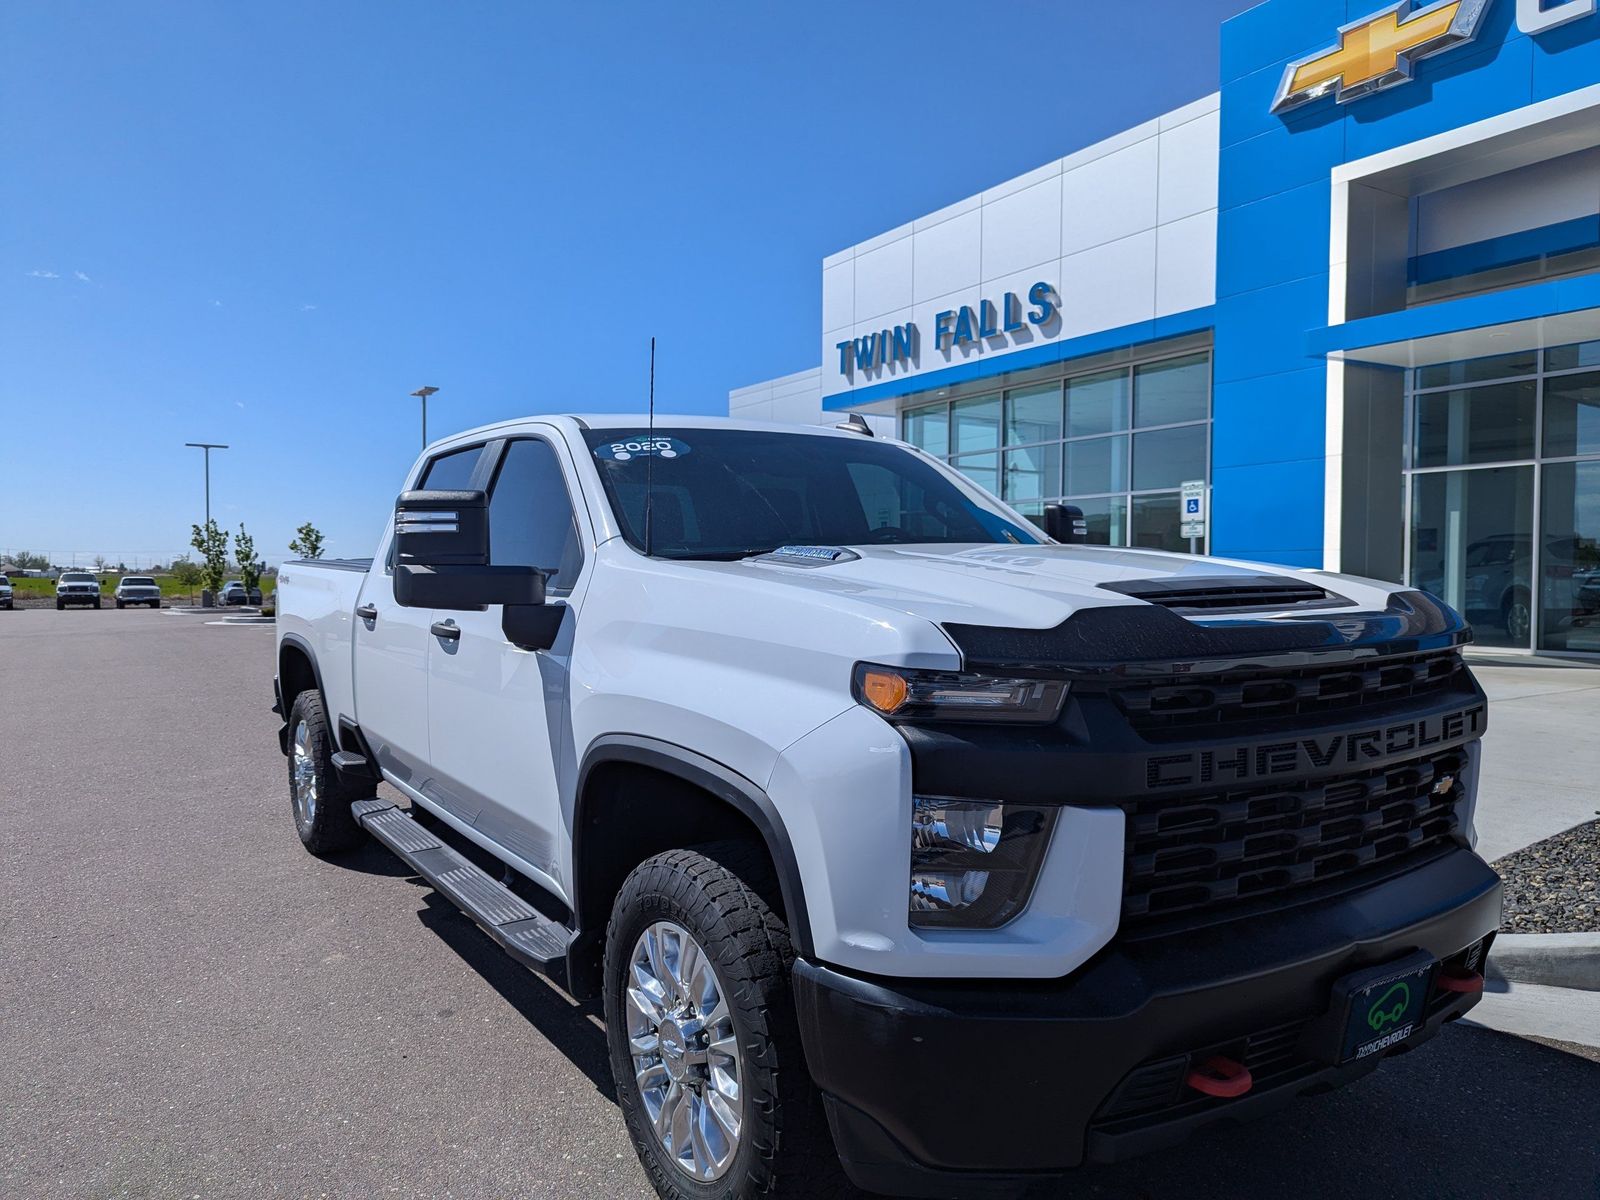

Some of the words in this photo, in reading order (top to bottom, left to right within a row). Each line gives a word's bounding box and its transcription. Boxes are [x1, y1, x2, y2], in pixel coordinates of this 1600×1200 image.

[836, 322, 914, 375] TWIN
[935, 281, 1055, 350] FALLS
[610, 441, 672, 452] 2020
[1146, 705, 1484, 789] CHEVROLET
